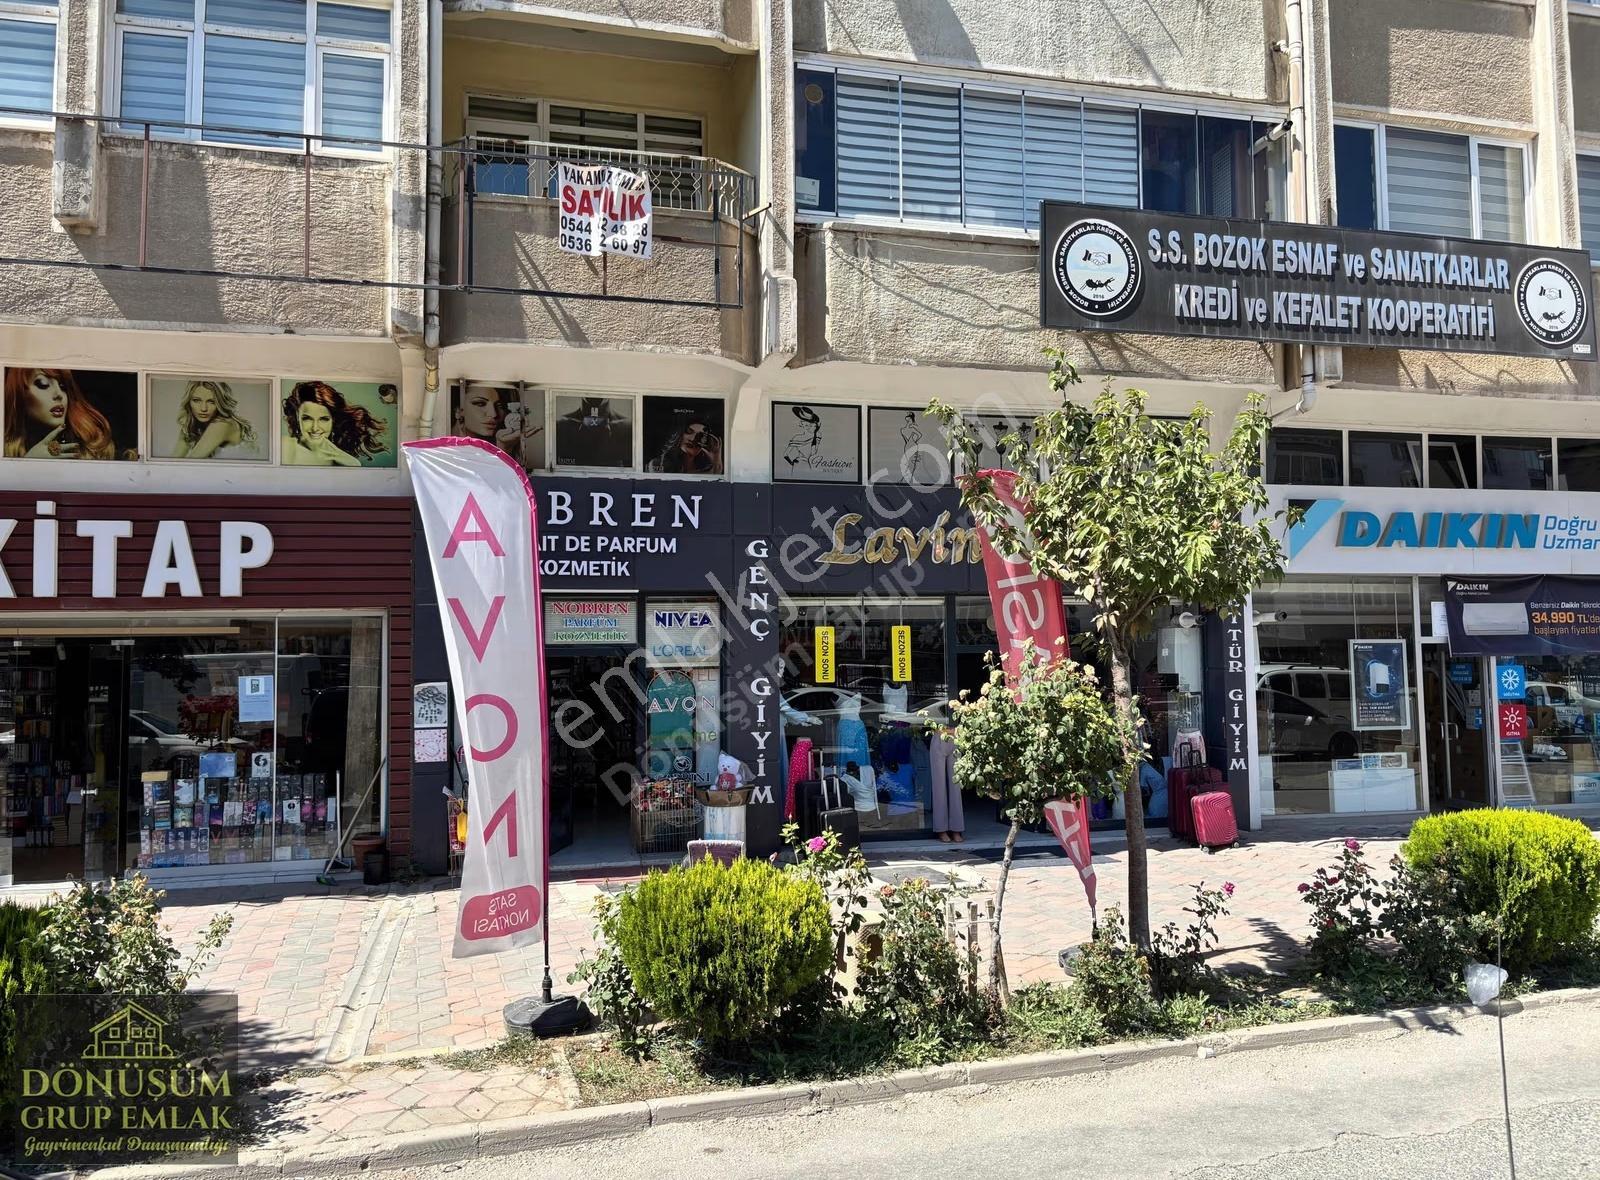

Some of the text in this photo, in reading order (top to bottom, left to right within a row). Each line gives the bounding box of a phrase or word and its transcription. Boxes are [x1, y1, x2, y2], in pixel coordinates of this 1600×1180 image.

[560, 216, 592, 235] 0544
[560, 233, 592, 252] 0536
[612, 237, 628, 252] 60
[633, 239, 648, 255] 97
[1148, 228, 1511, 290] S.S. BOZOK ESNAF ve SANATKARLAR
[1068, 290, 1089, 307] BOZOK
[1174, 279, 1495, 337] KREDİ ve KEFALET KOOPERATİFİ
[1336, 511, 1540, 548] DAIKIN
[1544, 515, 1598, 536] Doğru
[565, 536, 591, 552] DE
[597, 536, 677, 554] PARFUM
[1456, 583, 1488, 591] DAIKIN
[552, 602, 630, 615] NOBREN
[1531, 612, 1575, 624] 34.990
[563, 616, 618, 628] PARFÜM
[654, 609, 715, 629] NIVEA
[1534, 626, 1569, 636] başlayan
[821, 630, 830, 680] SEZON SONU
[748, 540, 775, 805] GENÇ GİYİM
[648, 696, 716, 714] AVON
[1229, 688, 1248, 771] GİYİM
